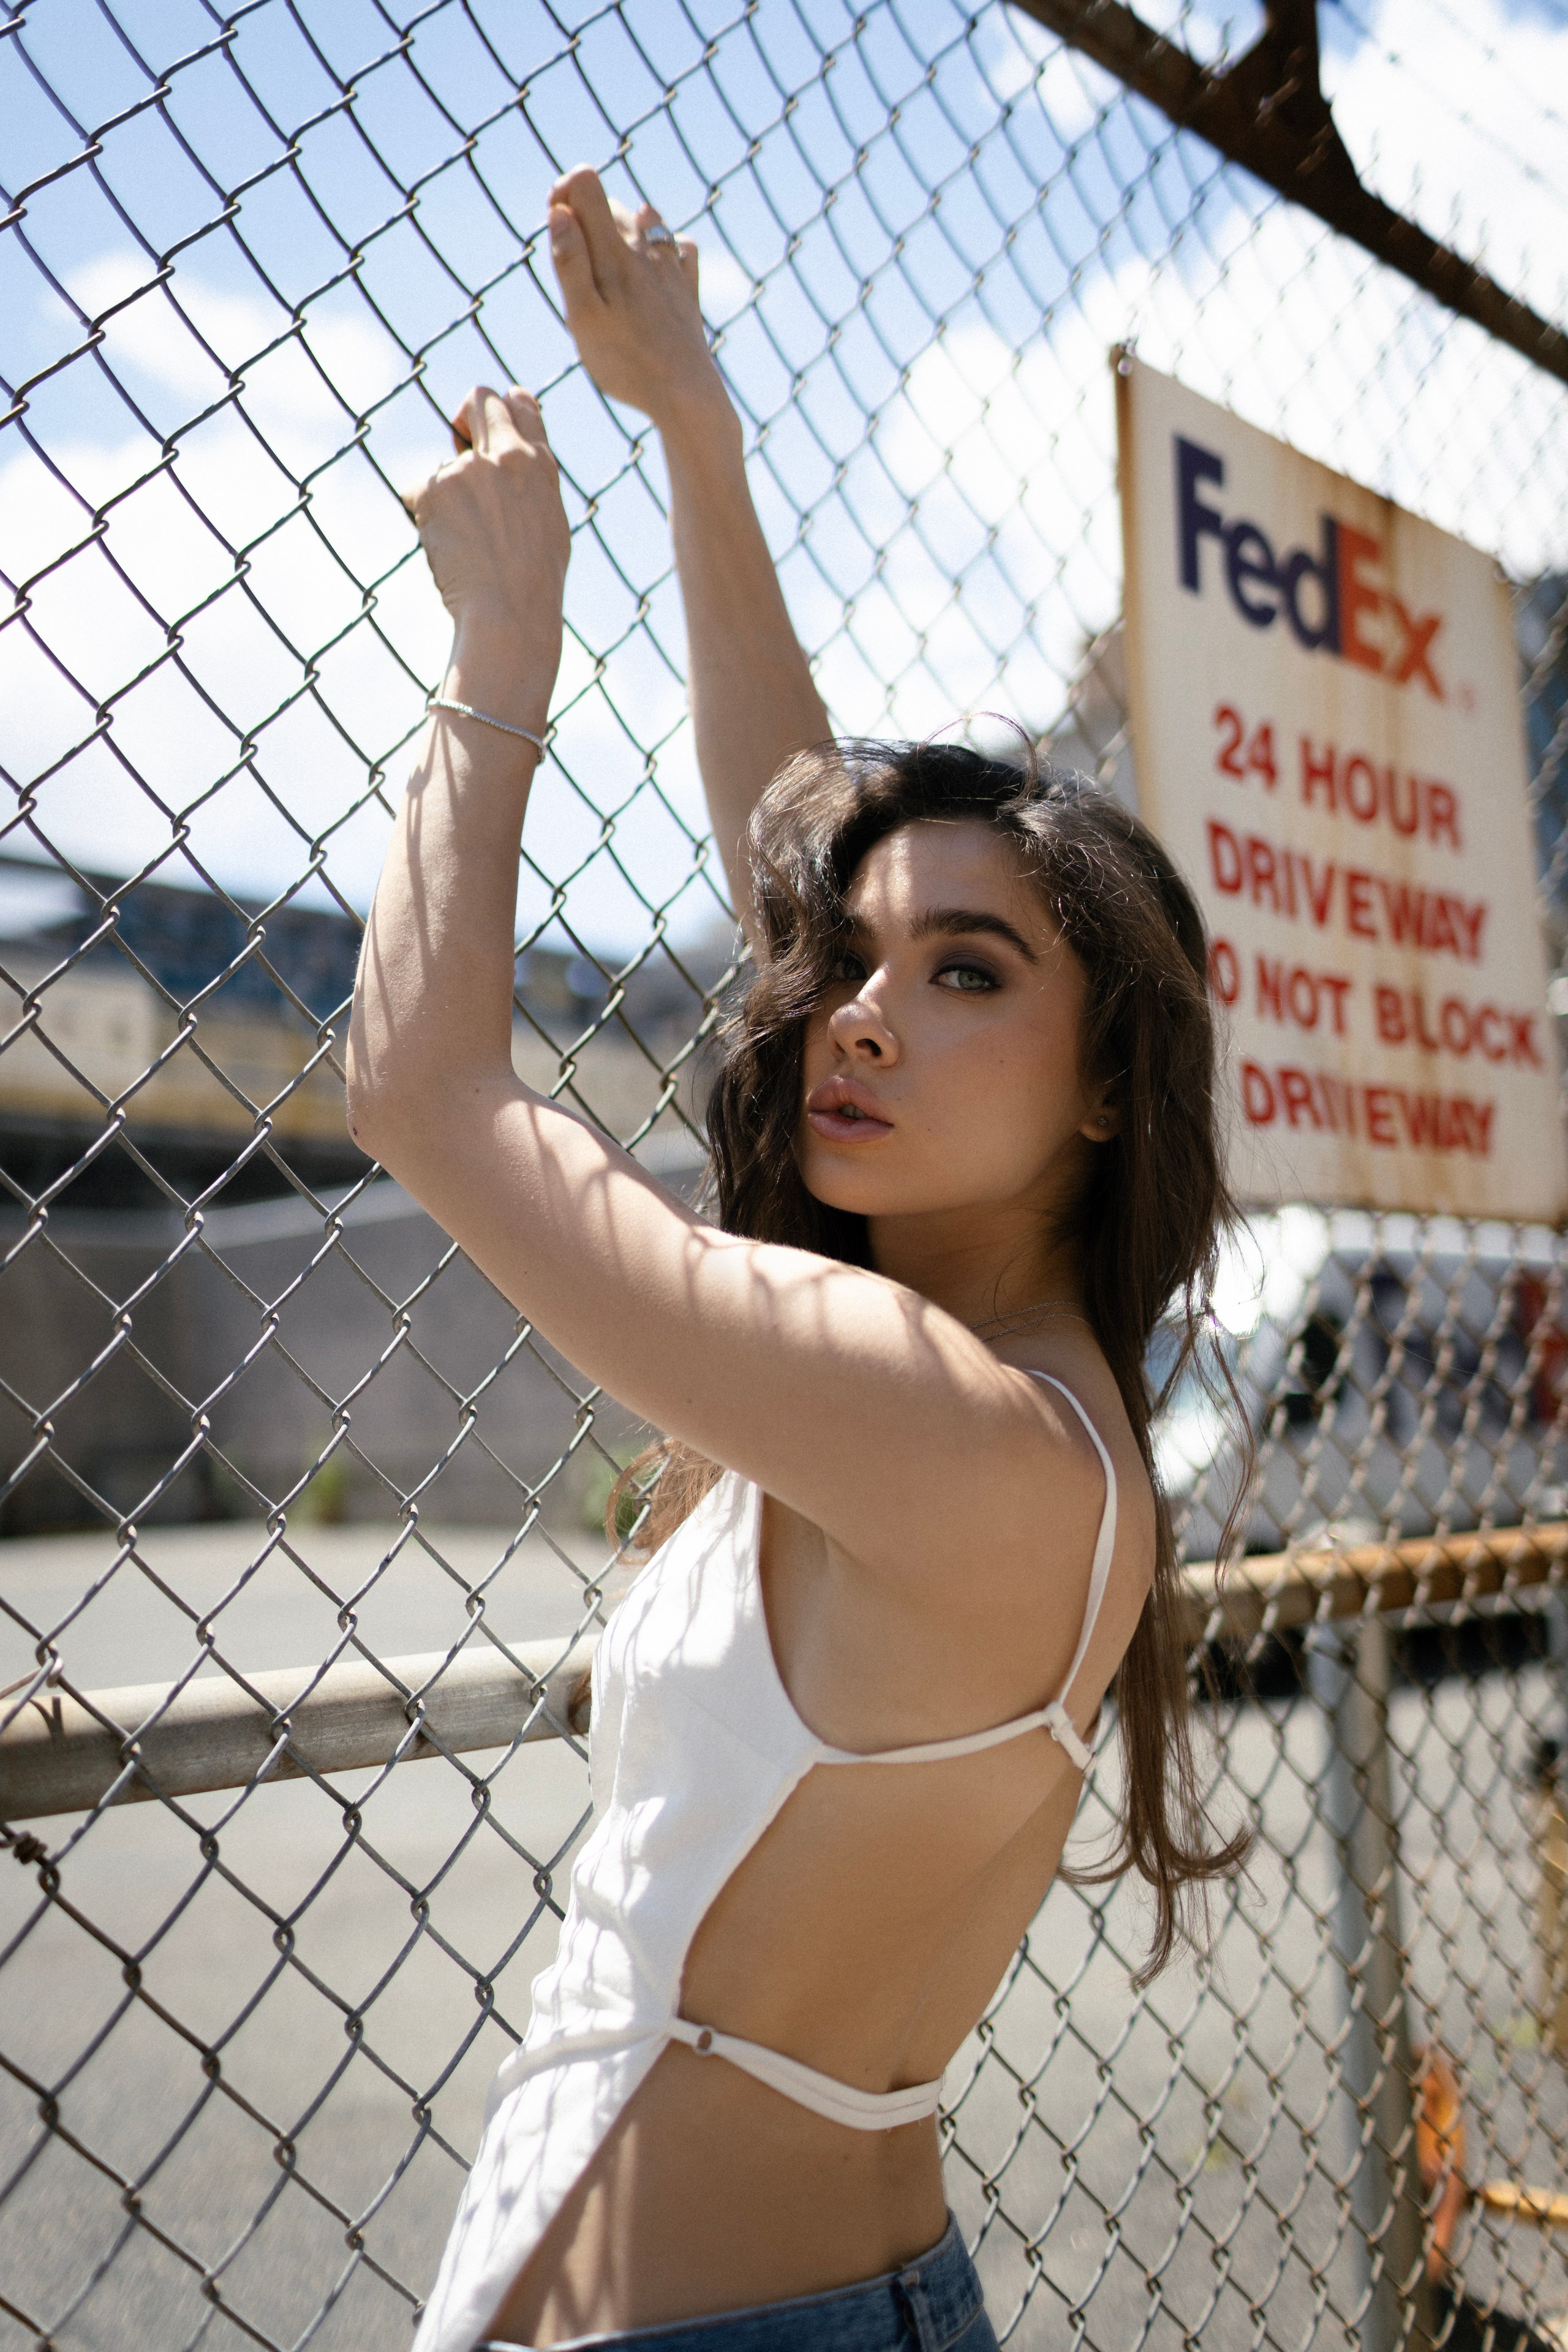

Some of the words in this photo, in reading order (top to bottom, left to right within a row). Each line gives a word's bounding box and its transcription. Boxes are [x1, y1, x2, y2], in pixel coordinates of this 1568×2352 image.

[1174, 434, 1445, 704] FedEx
[1215, 704, 1276, 793] 24
[1300, 736, 1462, 852] HOUR
[1206, 817, 1487, 963] DRIVEWAY
[1207, 938, 1240, 1005] O
[1255, 953, 1351, 1038] NOT
[1374, 984, 1544, 1072] BLOCK
